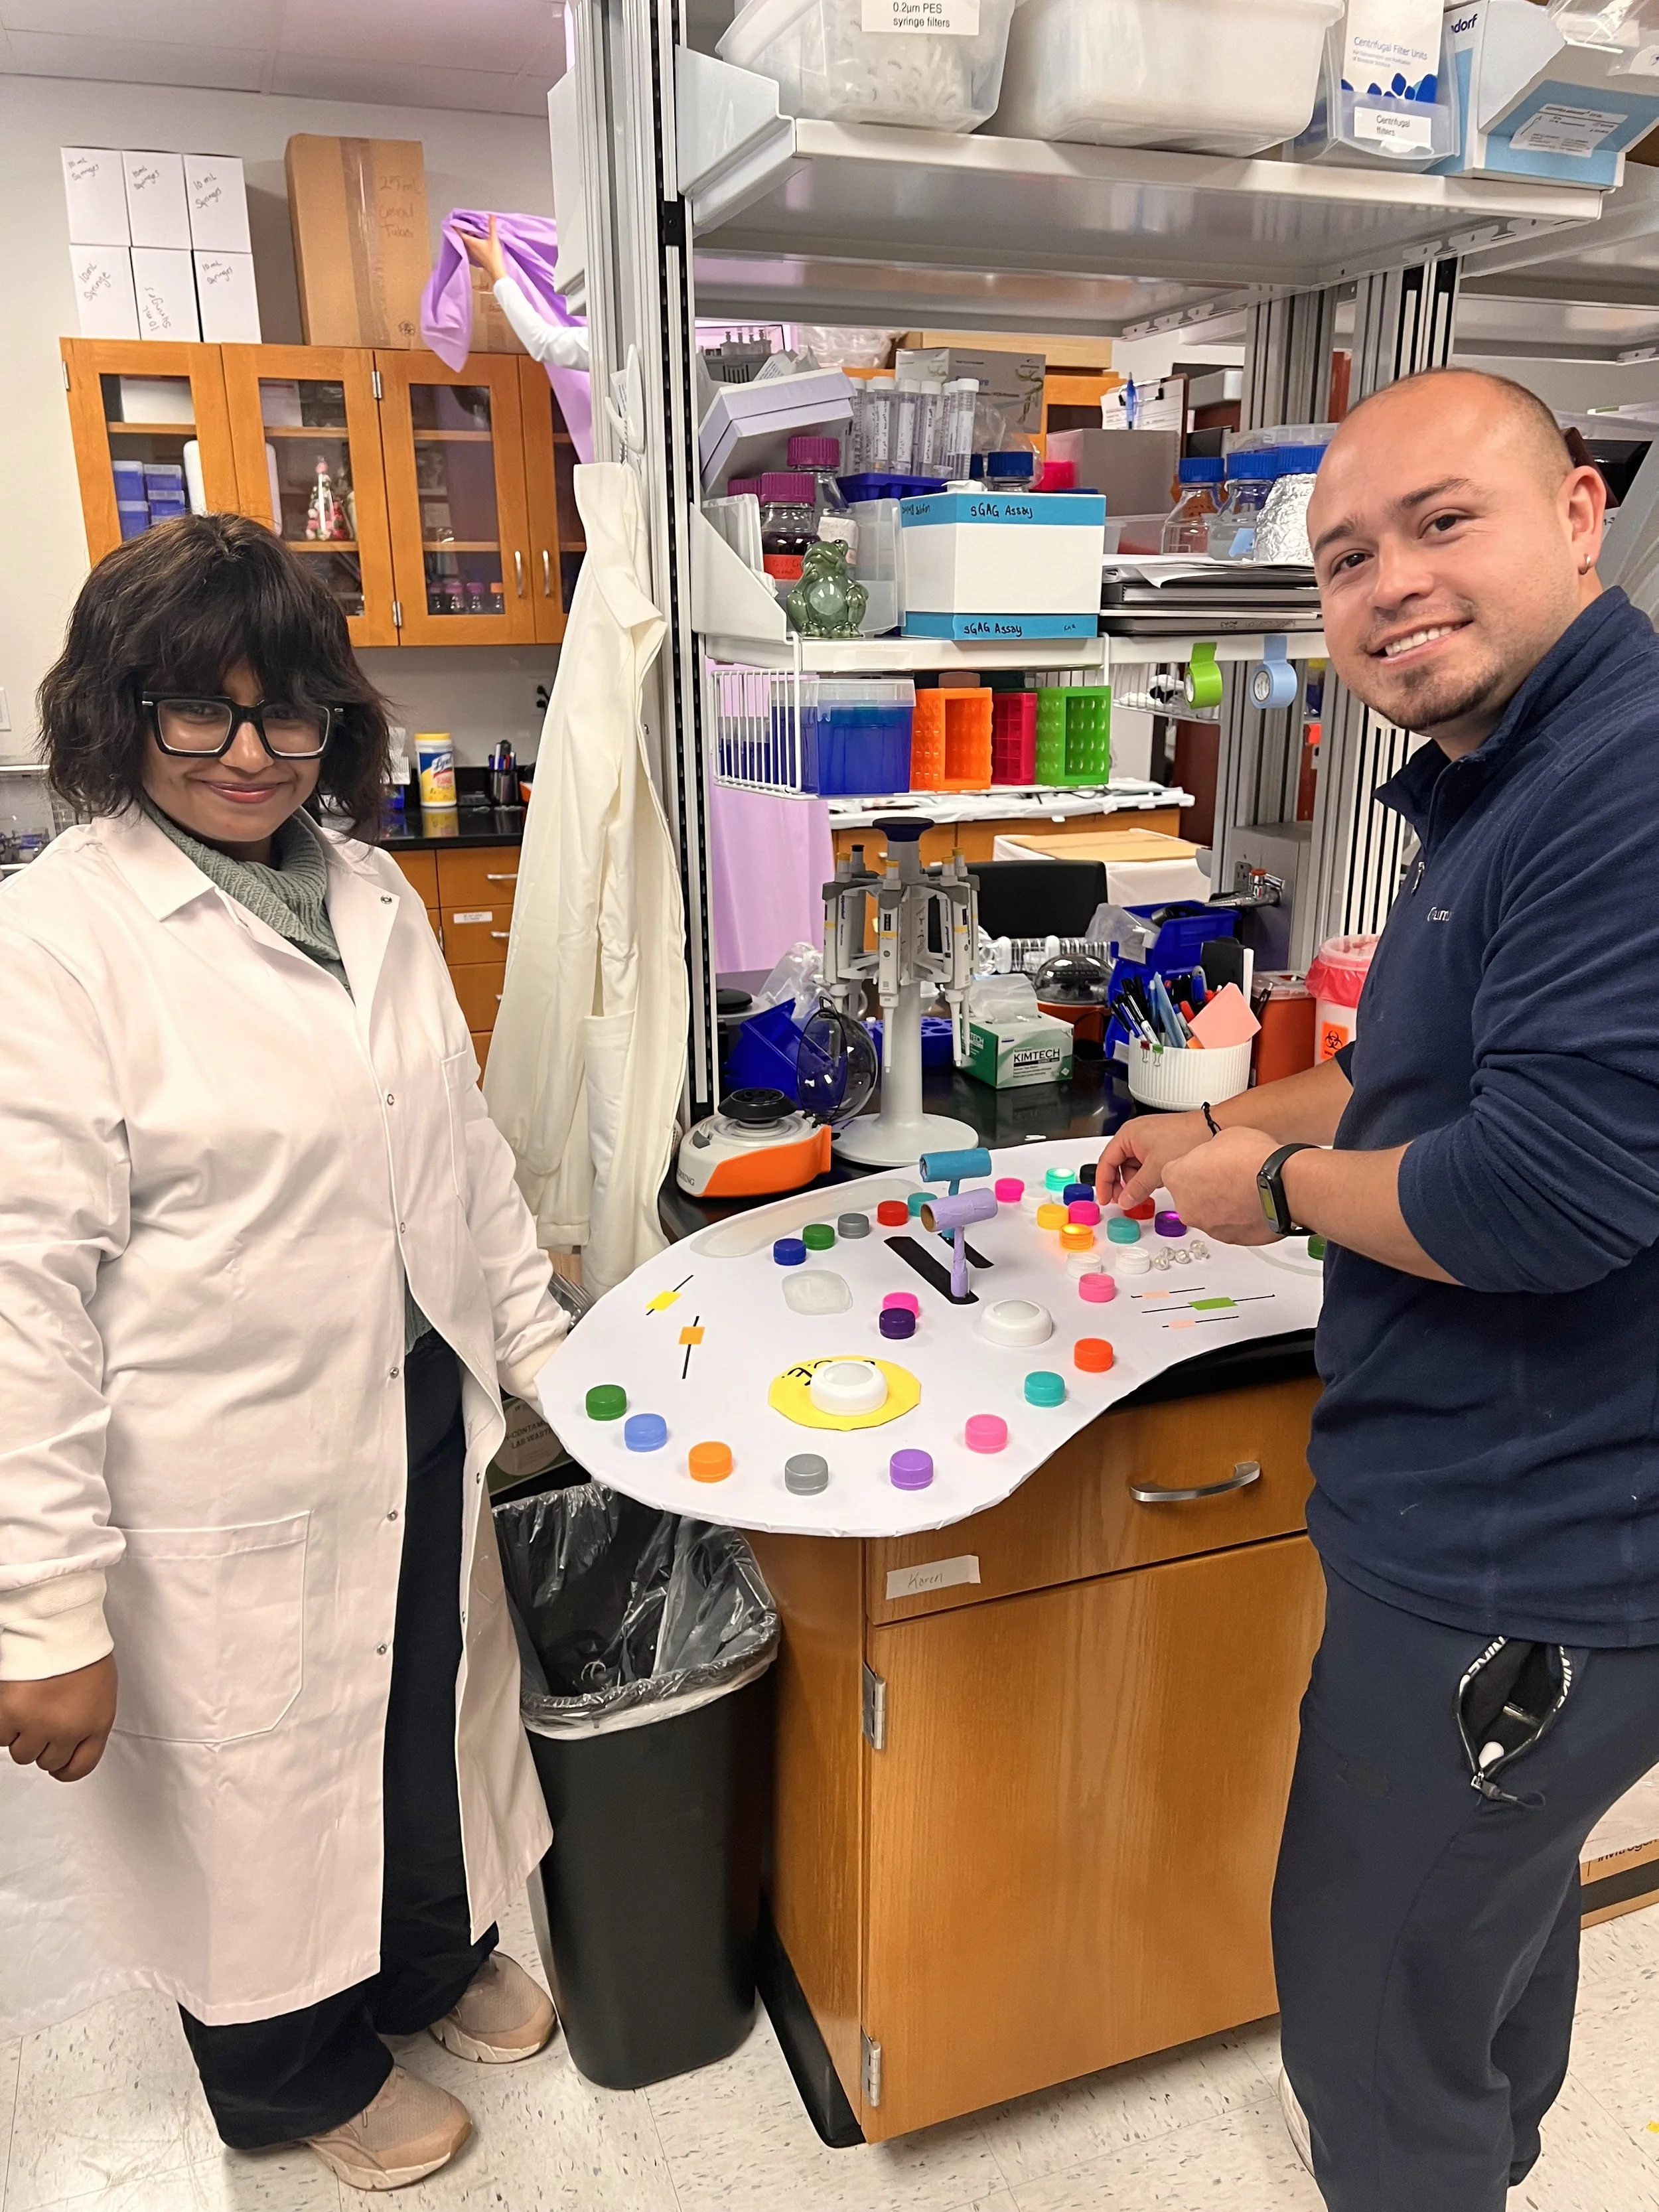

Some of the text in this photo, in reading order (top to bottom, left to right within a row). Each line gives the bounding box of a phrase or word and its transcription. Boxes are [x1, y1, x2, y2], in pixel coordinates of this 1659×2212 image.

[922, 3, 942, 14] PES
[893, 16, 950, 28] syringe filters
[1353, 36, 1428, 60] Centrifugal Filter Units
[1376, 114, 1411, 128] Centrifugal
[970, 502, 1033, 519] sGAG Assay
[964, 622, 991, 635] sGAG
[995, 623, 1023, 638] Assay
[1014, 1048, 1060, 1063] KIMTECH
